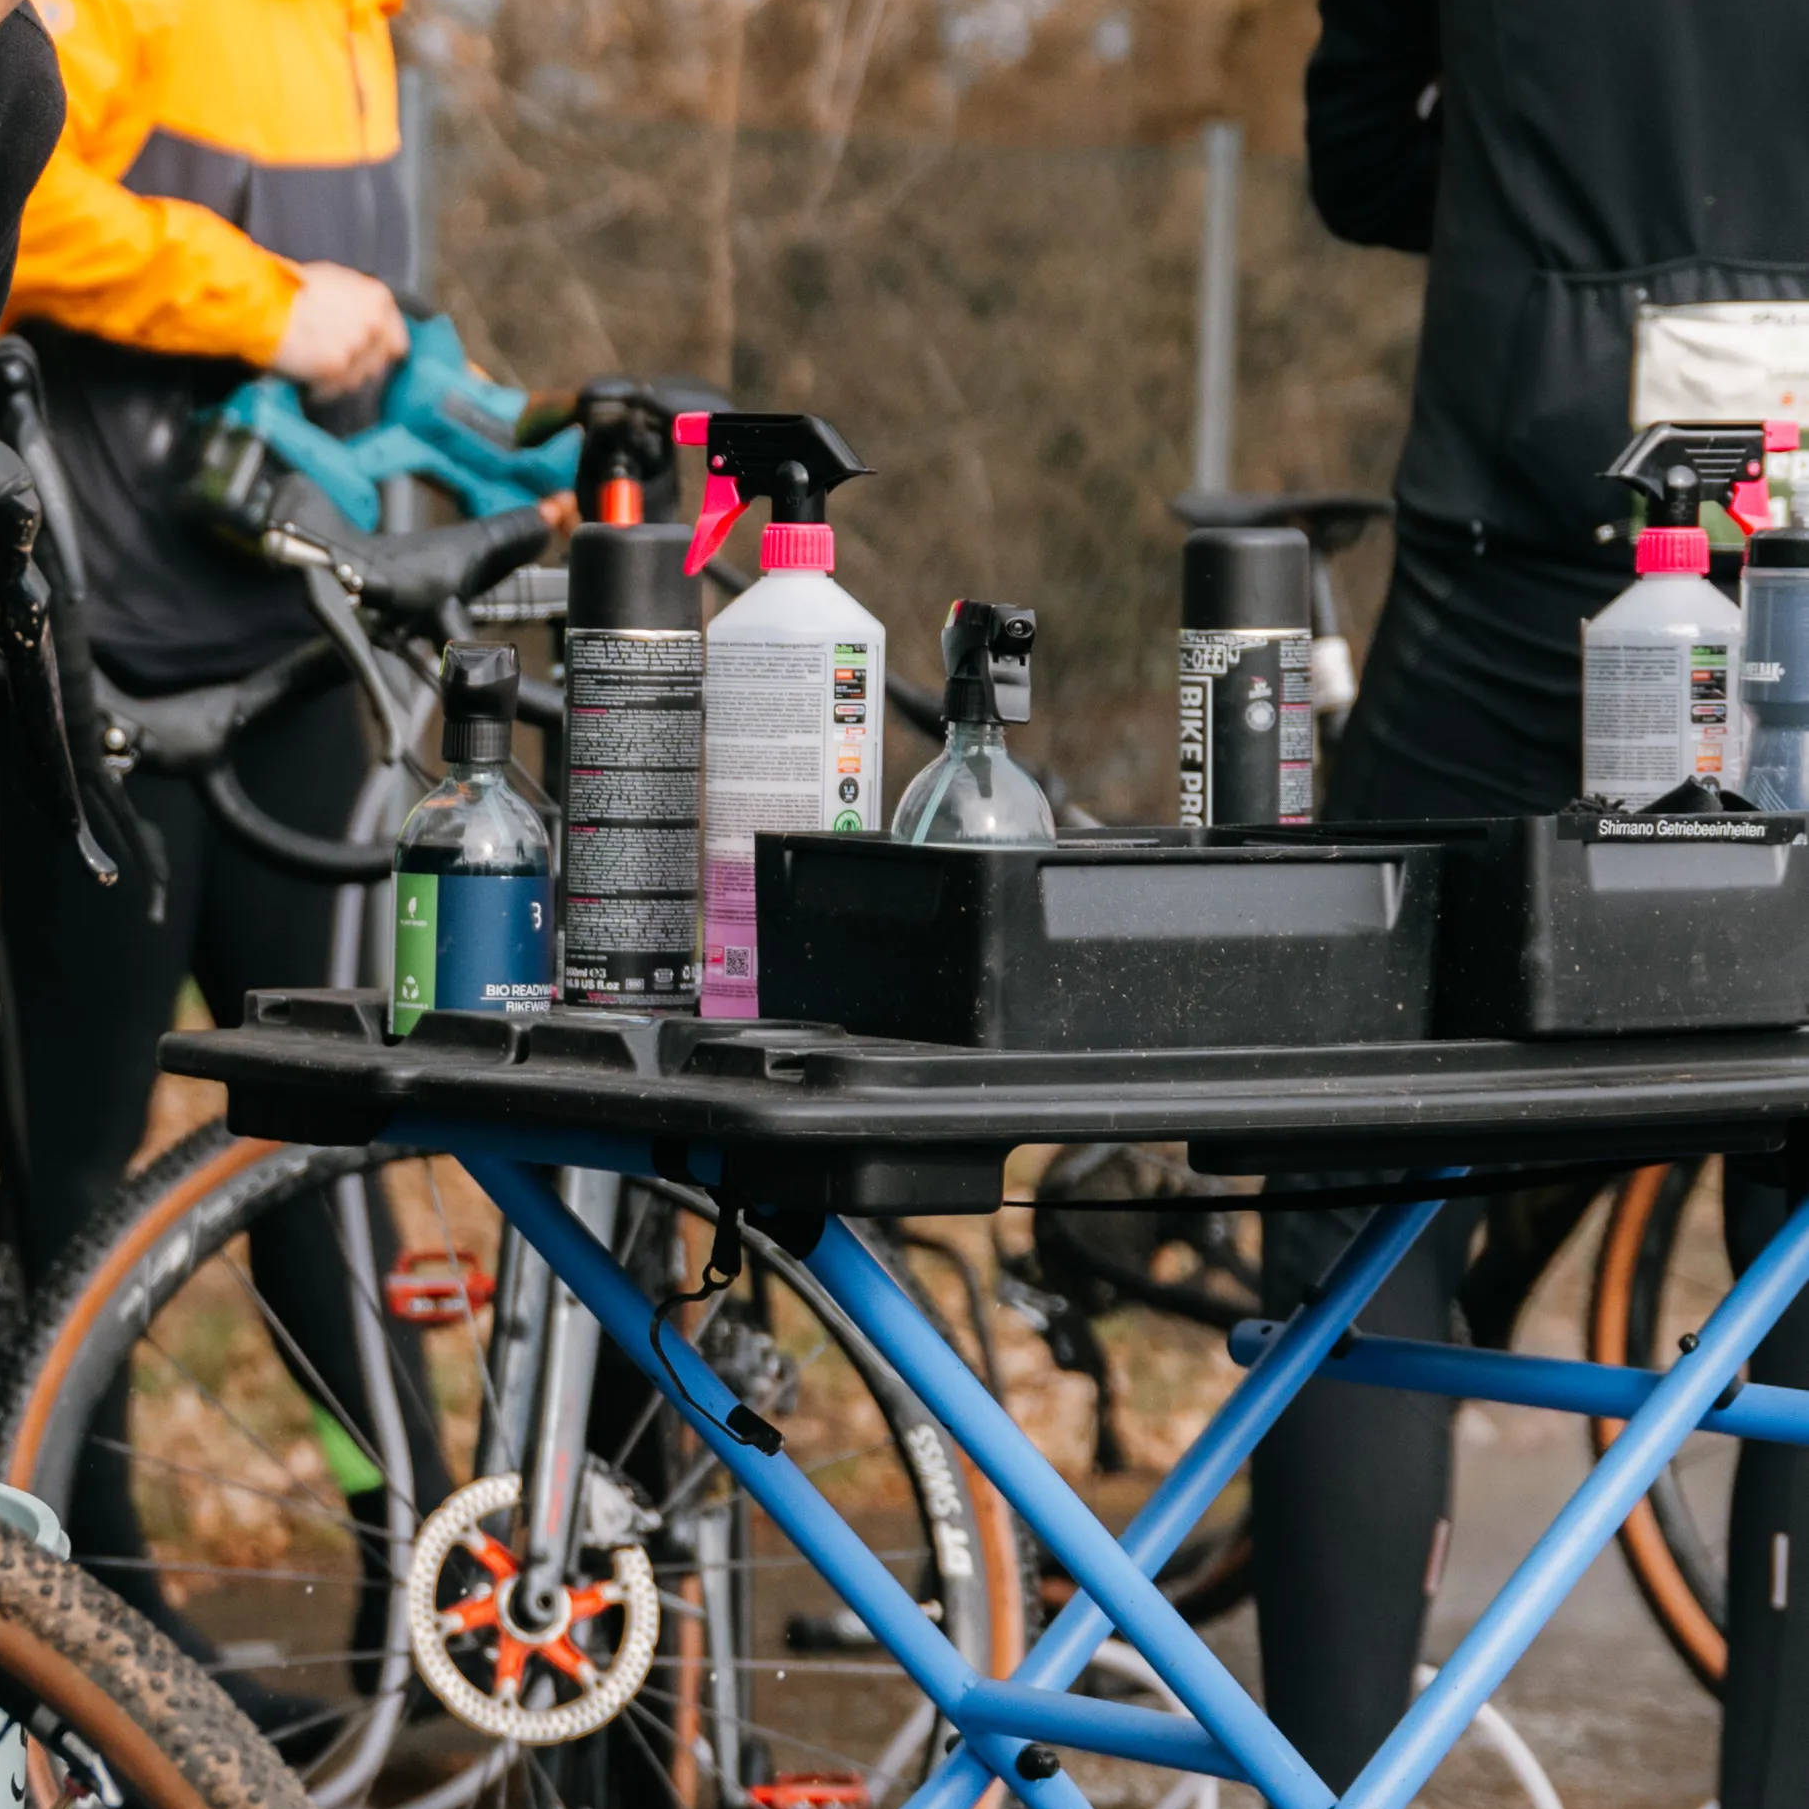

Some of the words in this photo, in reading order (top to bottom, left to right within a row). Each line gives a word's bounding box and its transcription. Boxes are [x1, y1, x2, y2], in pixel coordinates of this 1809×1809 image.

[1180, 685, 1203, 763] BIKE
[1599, 818, 1654, 836] Shimano
[1656, 819, 1766, 838] Getriebeeinheiten
[485, 984, 511, 996] BIO
[907, 1423, 962, 1517] SWISS
[934, 1520, 974, 1575] DT
